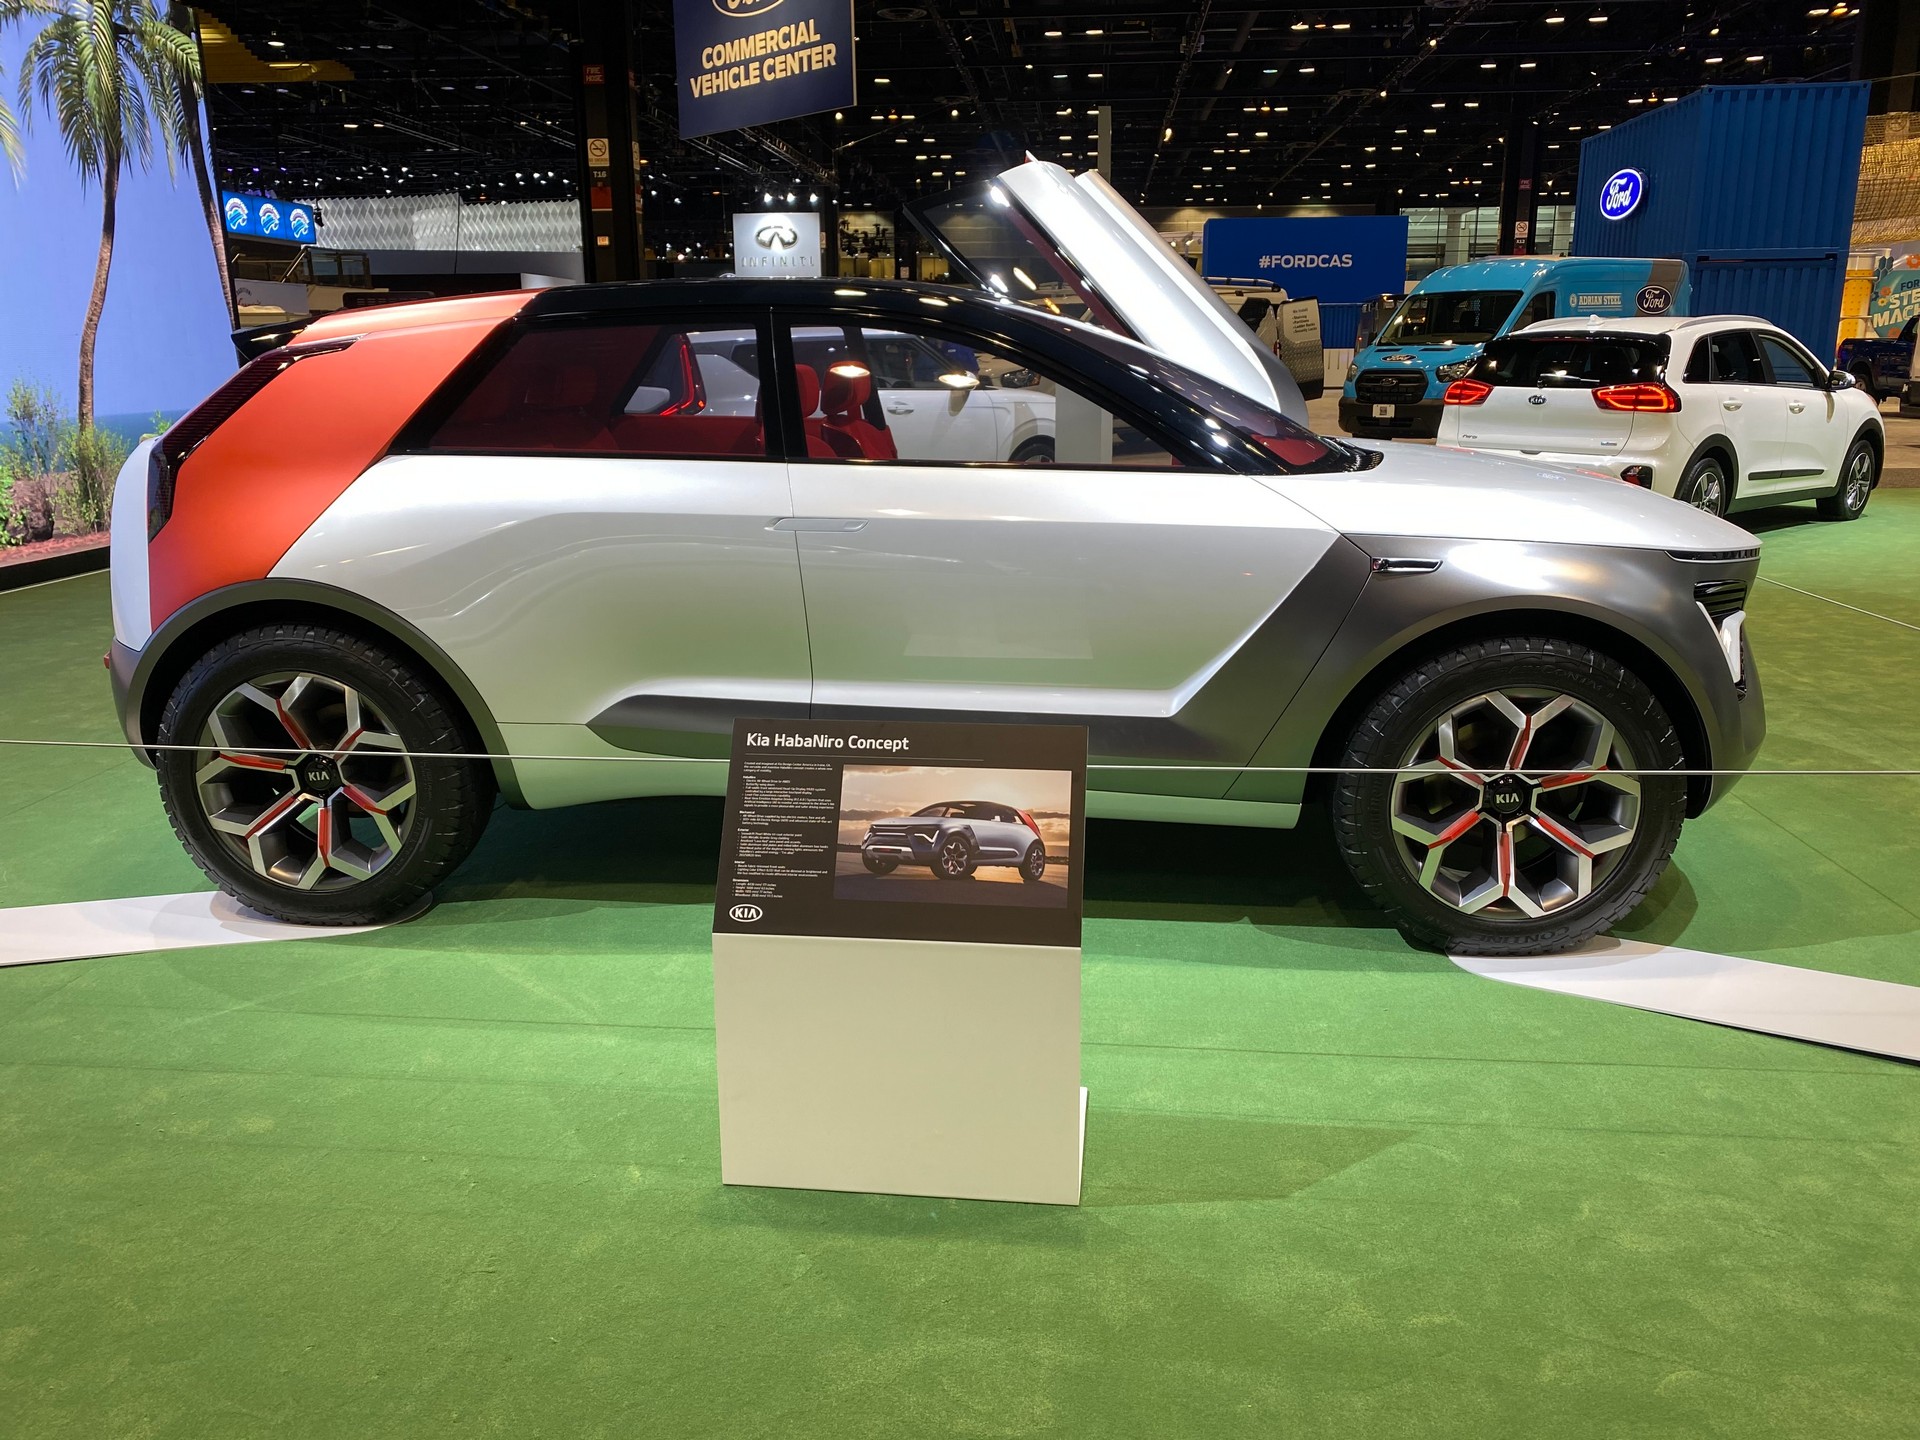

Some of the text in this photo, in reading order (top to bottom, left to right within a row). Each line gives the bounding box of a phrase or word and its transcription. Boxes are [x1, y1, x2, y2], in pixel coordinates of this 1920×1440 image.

[702, 19, 821, 70] COMMERCIAL
[690, 43, 836, 98] VEHICLE CENTER
[1606, 177, 1633, 210] Ford
[741, 256, 815, 267] INFINITI
[1259, 254, 1353, 269] #FORDCAS
[1578, 295, 1622, 305] ADRIAN STEEL
[1643, 288, 1665, 309] Ford
[746, 732, 909, 752] Kia HabaNiro Concept
[308, 771, 330, 782] KIA
[1496, 793, 1520, 804] KIA
[735, 908, 757, 918] KIA
